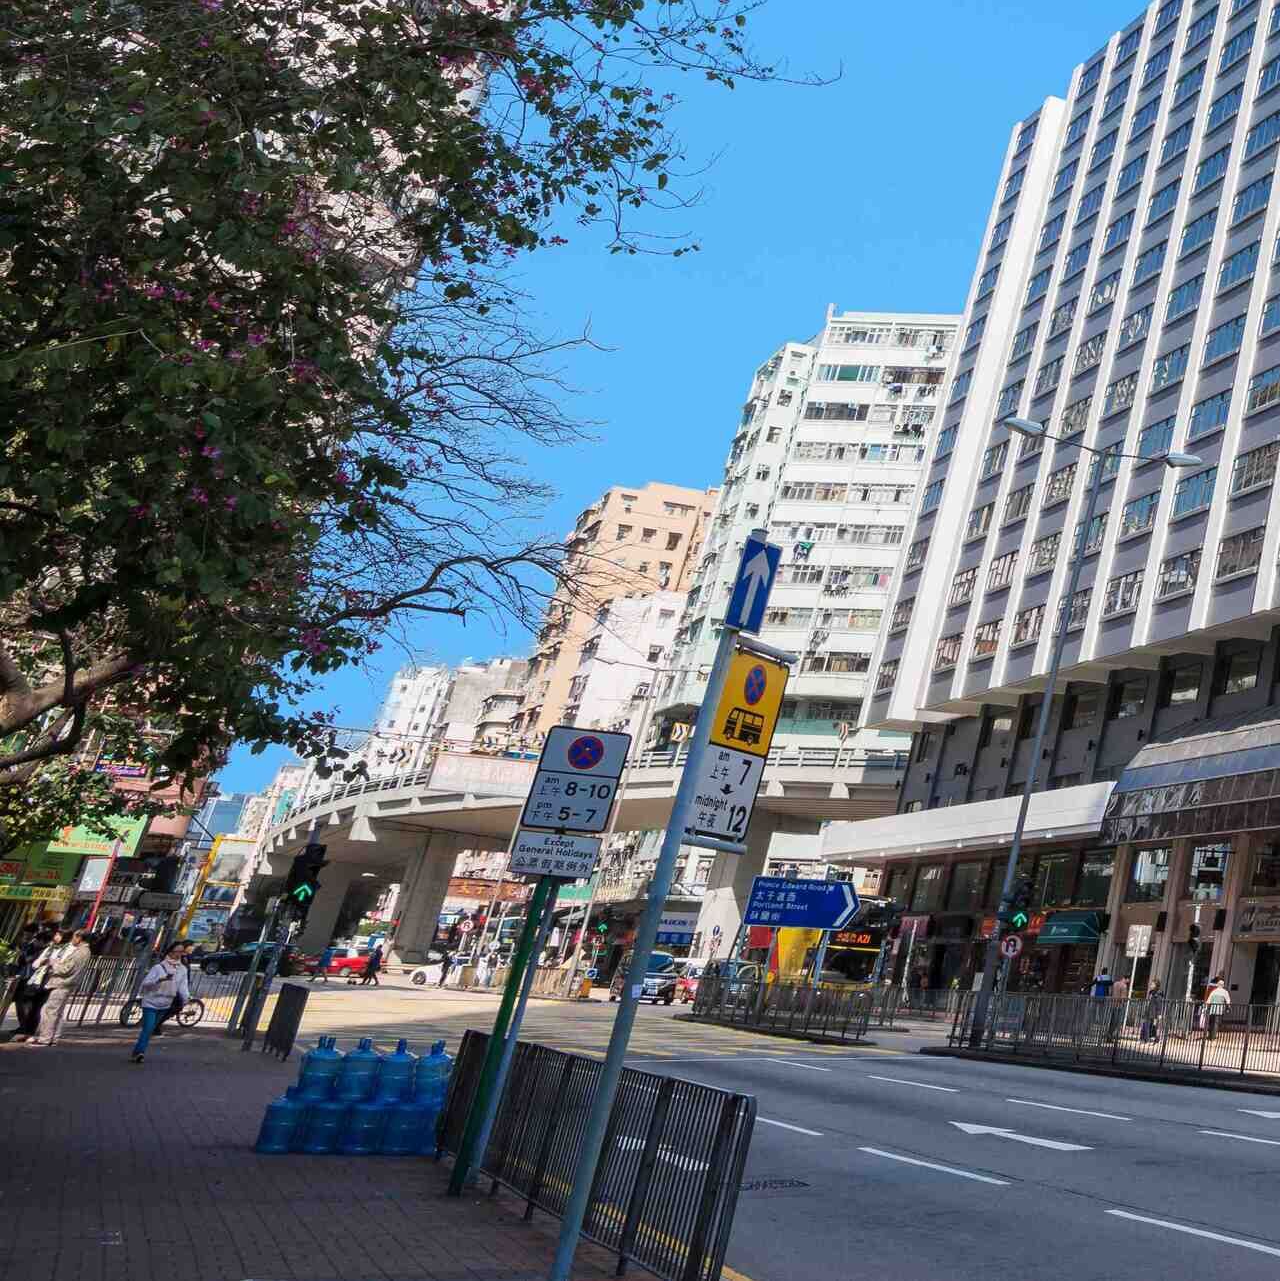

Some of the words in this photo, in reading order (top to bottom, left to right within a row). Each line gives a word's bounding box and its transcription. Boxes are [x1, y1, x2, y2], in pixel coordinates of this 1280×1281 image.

[719, 750, 730, 761] am
[709, 766, 729, 780] 上午
[739, 759, 752, 785] 7
[544, 776, 560, 785] am
[536, 785, 561, 797] 上午
[565, 782, 611, 800] 8-10
[536, 801, 552, 810] pm
[694, 794, 728, 811] midnight
[531, 810, 553, 822] 下午
[697, 811, 717, 828] 午夜
[727, 805, 747, 832] 12
[544, 837, 574, 849] Except
[519, 843, 555, 856] General
[555, 849, 593, 860] Holidays
[781, 882, 808, 890] Edward
[808, 884, 826, 892] Road
[755, 891, 797, 902] 太子道西
[752, 901, 785, 911] Portland
[785, 902, 808, 912] Street
